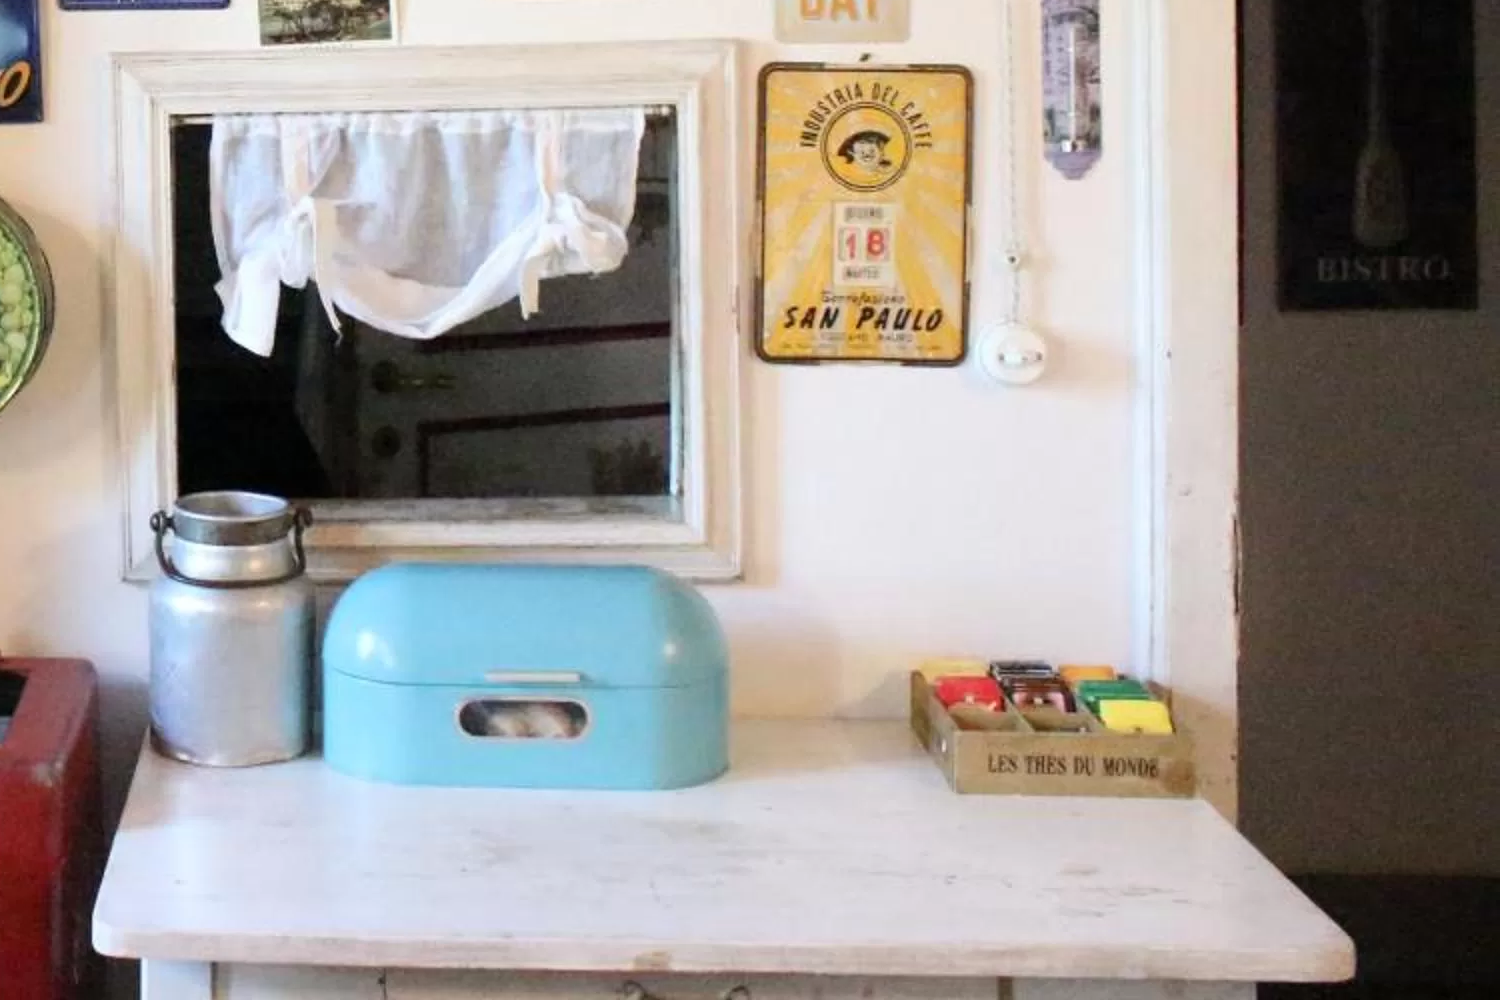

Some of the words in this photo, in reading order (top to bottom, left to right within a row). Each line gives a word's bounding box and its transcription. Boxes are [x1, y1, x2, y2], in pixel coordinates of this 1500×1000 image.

[799, 82, 864, 150] INDUSTRIA
[870, 81, 899, 108] DEL
[1316, 254, 1454, 283] BISTRO
[783, 305, 840, 330] SAN
[855, 306, 944, 333] PAULO
[986, 752, 1019, 774] LES
[1073, 754, 1097, 777] DU
